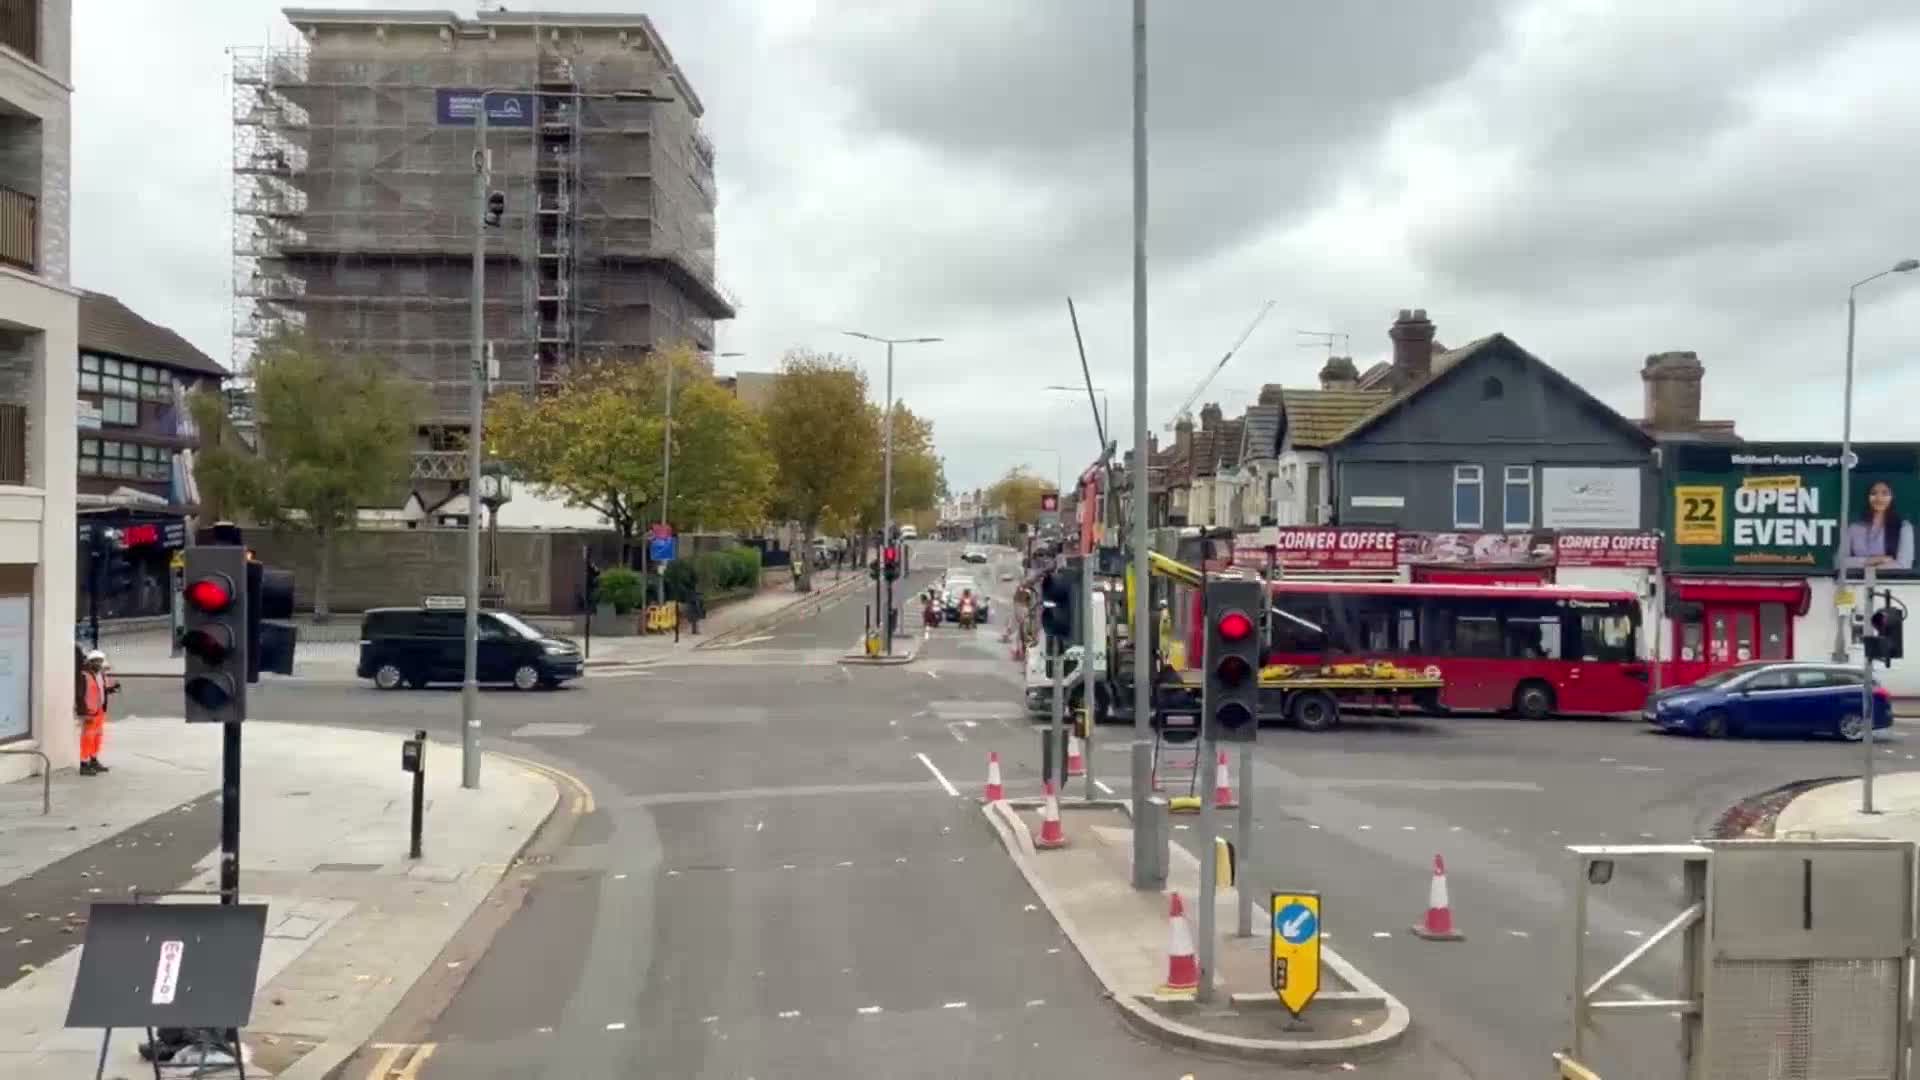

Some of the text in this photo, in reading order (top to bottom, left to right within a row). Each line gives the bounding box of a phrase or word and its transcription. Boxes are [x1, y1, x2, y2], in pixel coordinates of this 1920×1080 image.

[1774, 454, 1803, 465] Forest
[1805, 454, 1838, 467] College
[1683, 498, 1716, 521] 22
[1734, 487, 1820, 514] OPEN
[1277, 532, 1335, 549] CORNER
[1339, 532, 1396, 549] COFFEE
[1558, 535, 1659, 550] CORNER COFFEE
[1733, 518, 1837, 546] EVENT
[159, 942, 181, 994] metro
